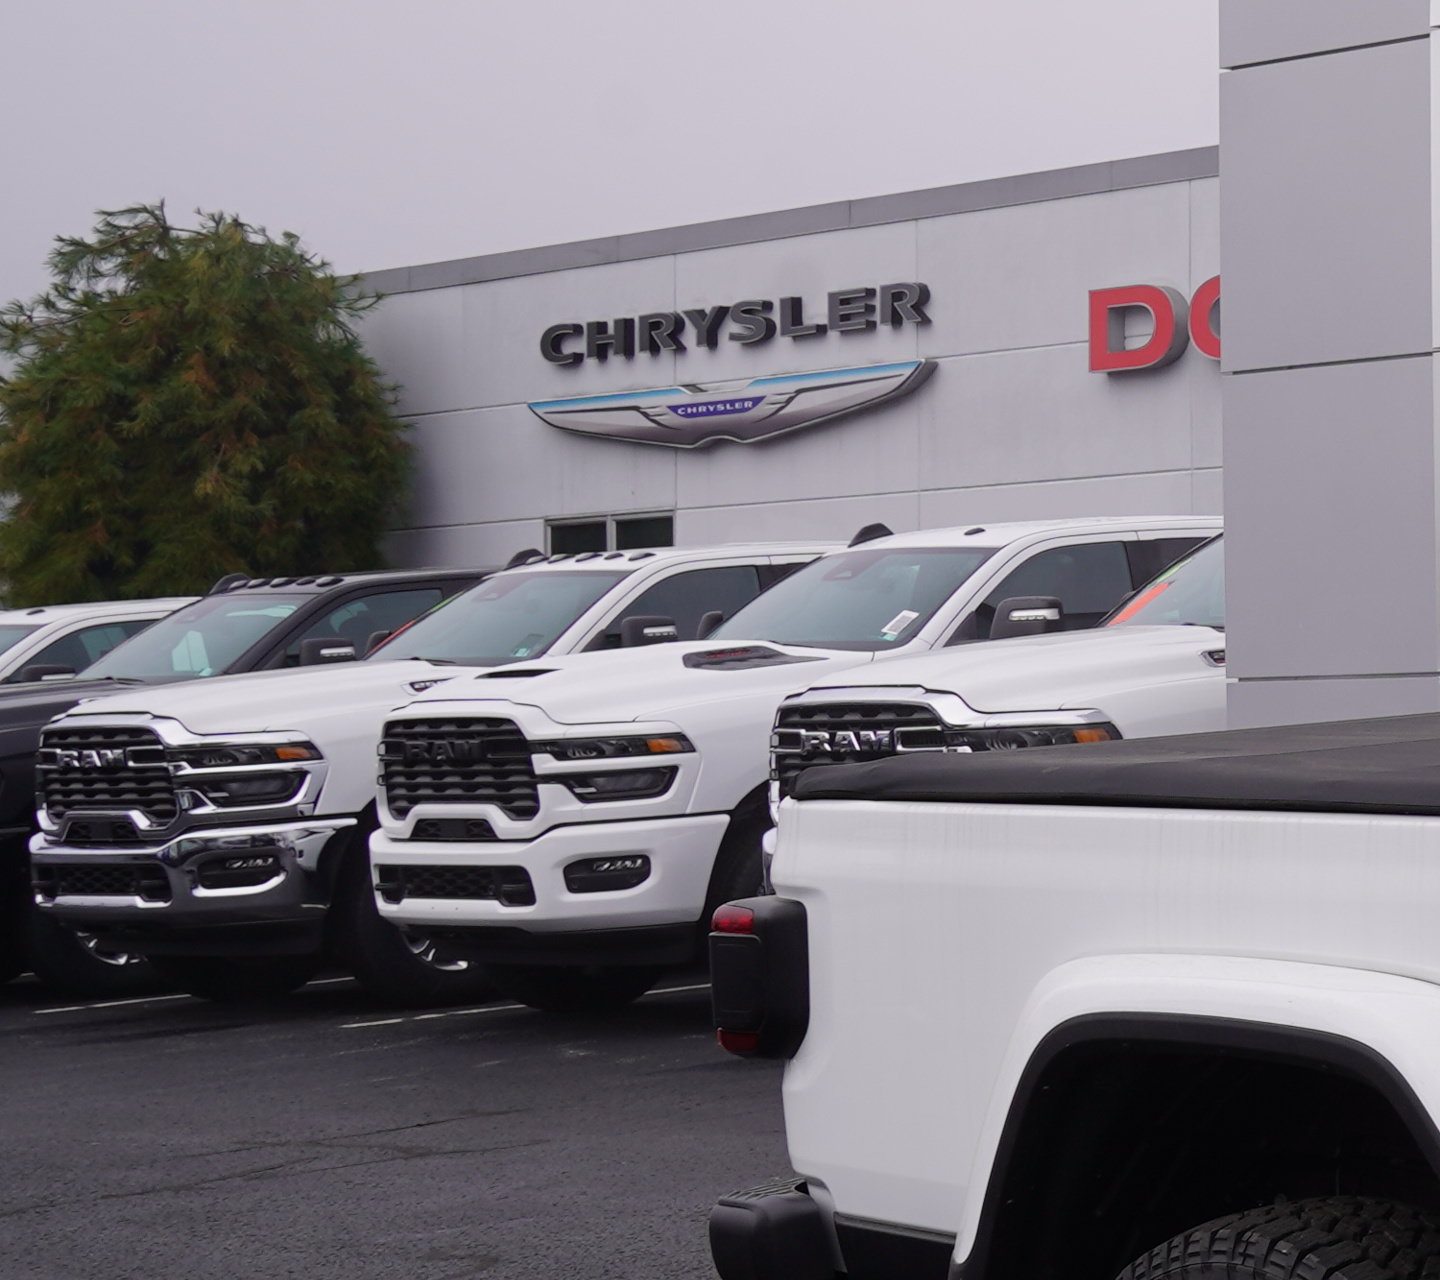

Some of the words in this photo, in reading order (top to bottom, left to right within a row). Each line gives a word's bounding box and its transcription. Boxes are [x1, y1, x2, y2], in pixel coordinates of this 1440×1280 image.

[539, 281, 932, 366] CHRYSLER
[677, 399, 754, 416] CHRYSLER
[405, 739, 486, 760] RAM
[803, 730, 891, 752] RAM
[56, 748, 125, 768] RAM
